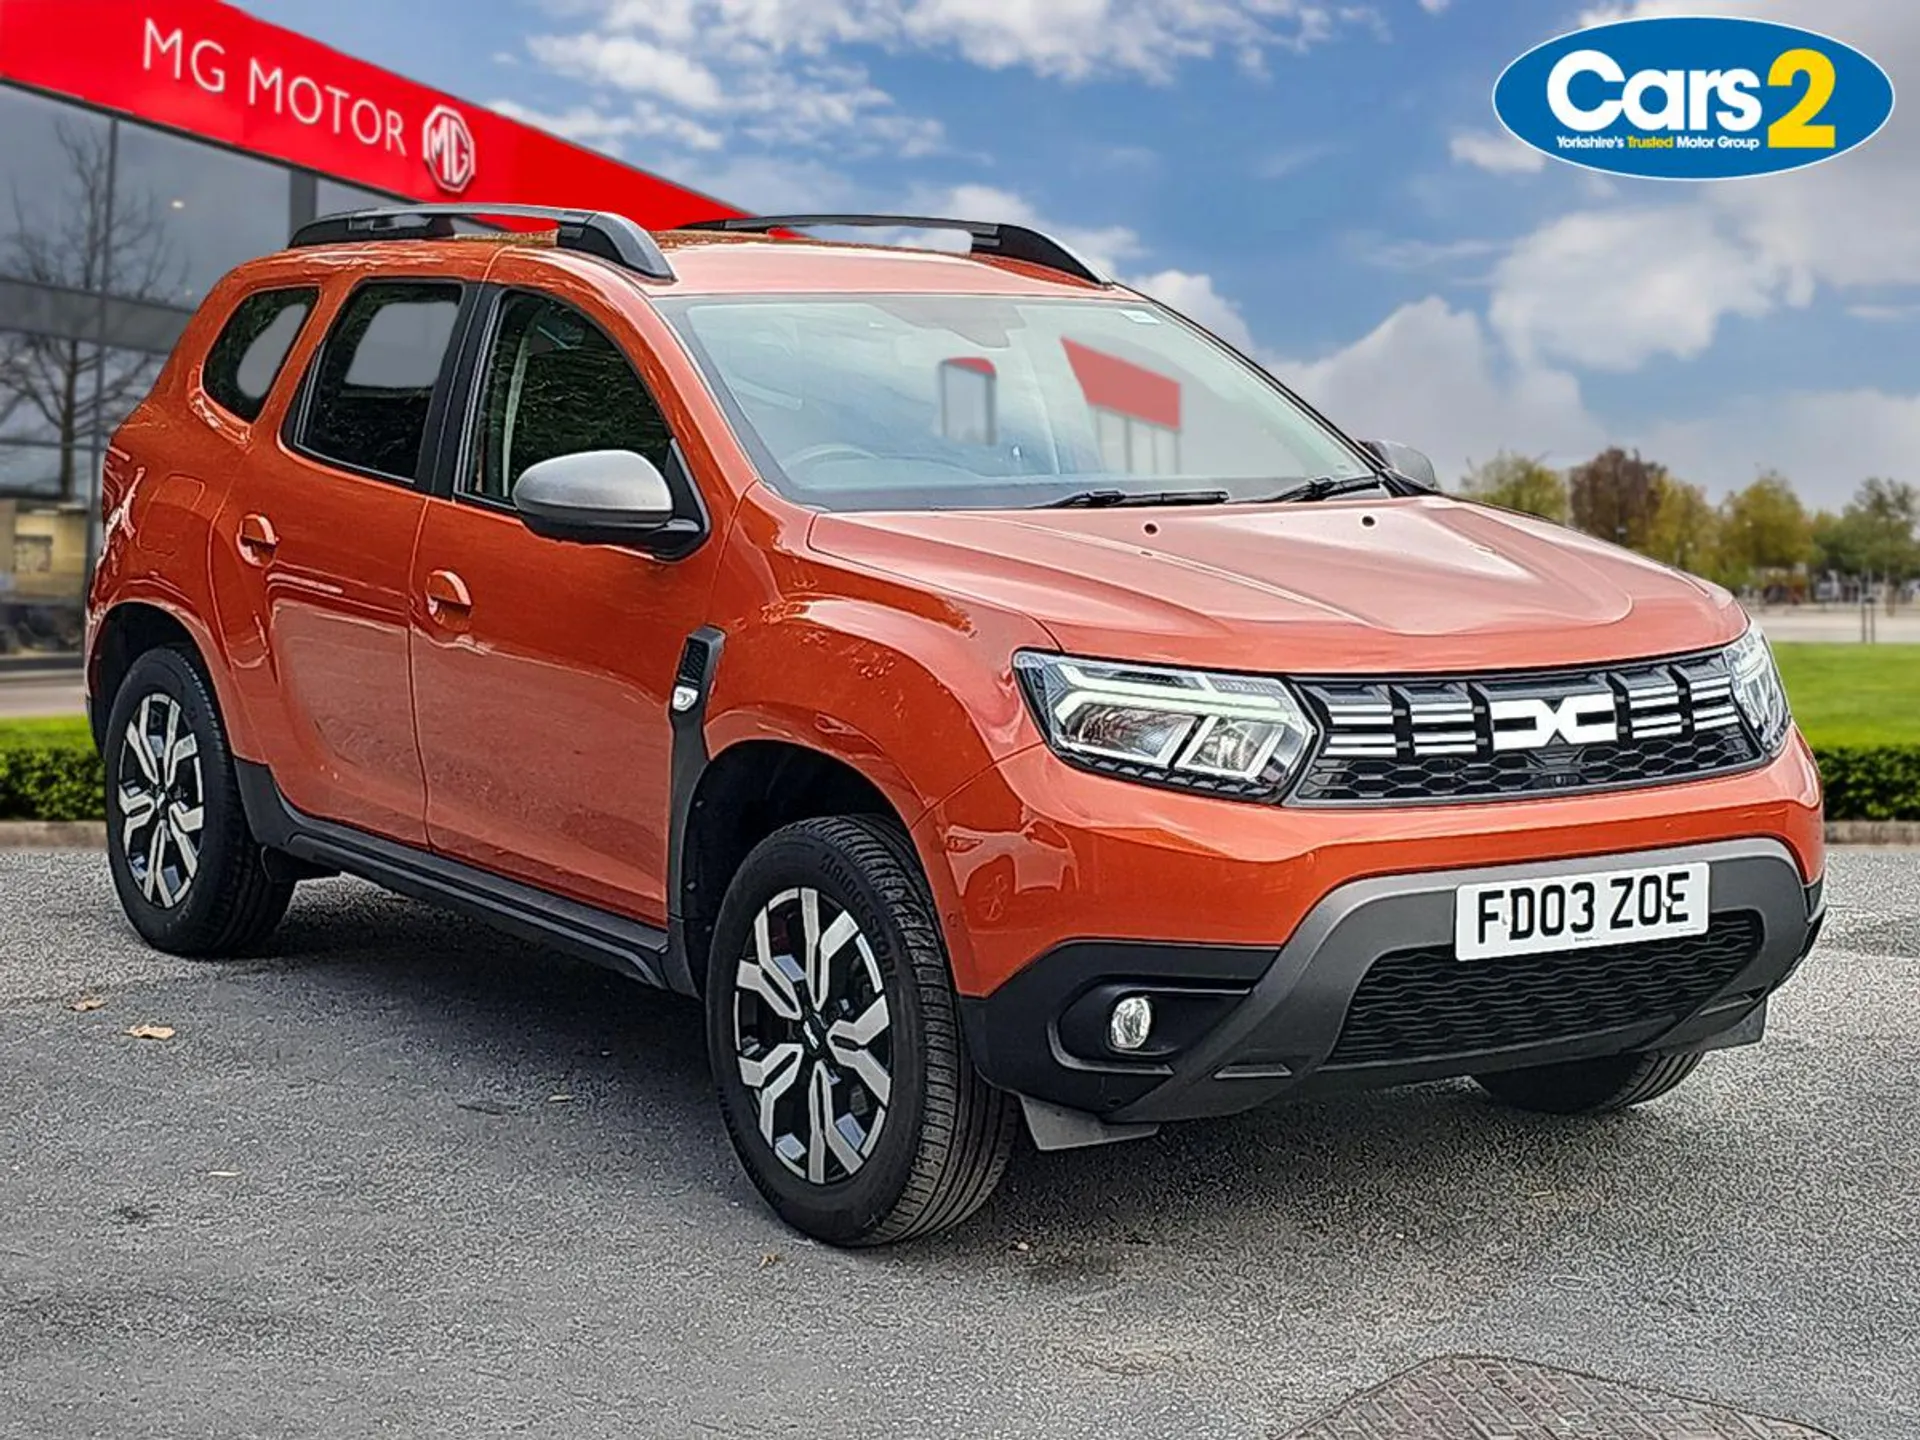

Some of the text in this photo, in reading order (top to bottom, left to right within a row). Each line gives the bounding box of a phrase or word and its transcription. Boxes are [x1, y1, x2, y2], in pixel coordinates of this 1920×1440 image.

[143, 17, 407, 156] MG MOTOR
[428, 112, 472, 187] MG
[1477, 871, 1690, 944] FD03 ZOE
